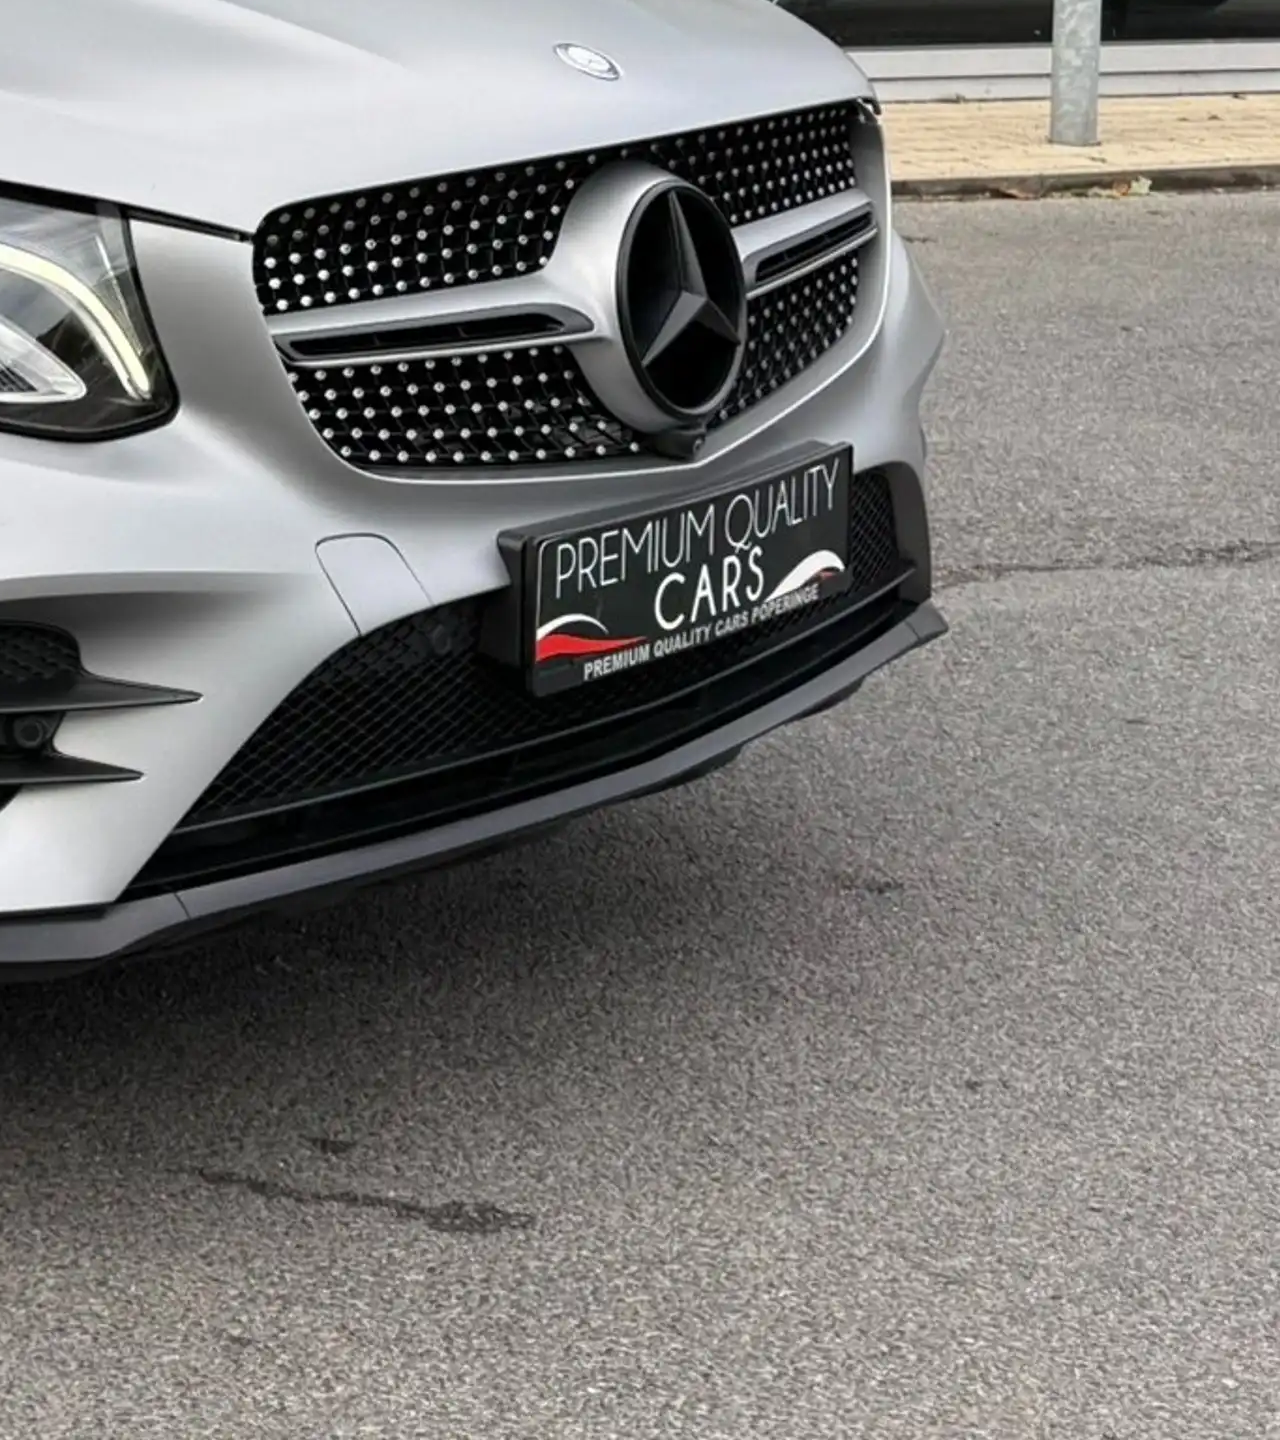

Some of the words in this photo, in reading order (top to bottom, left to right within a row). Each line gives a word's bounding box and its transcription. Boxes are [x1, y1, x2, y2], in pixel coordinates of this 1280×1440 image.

[555, 503, 715, 600] PREMIUM
[724, 458, 840, 554] QUALITY
[583, 645, 650, 681] PREMIUM
[652, 624, 711, 657] QUALITY
[715, 612, 750, 638] CARS
[751, 583, 821, 624] POPERINGE
[653, 545, 765, 630] CARS
